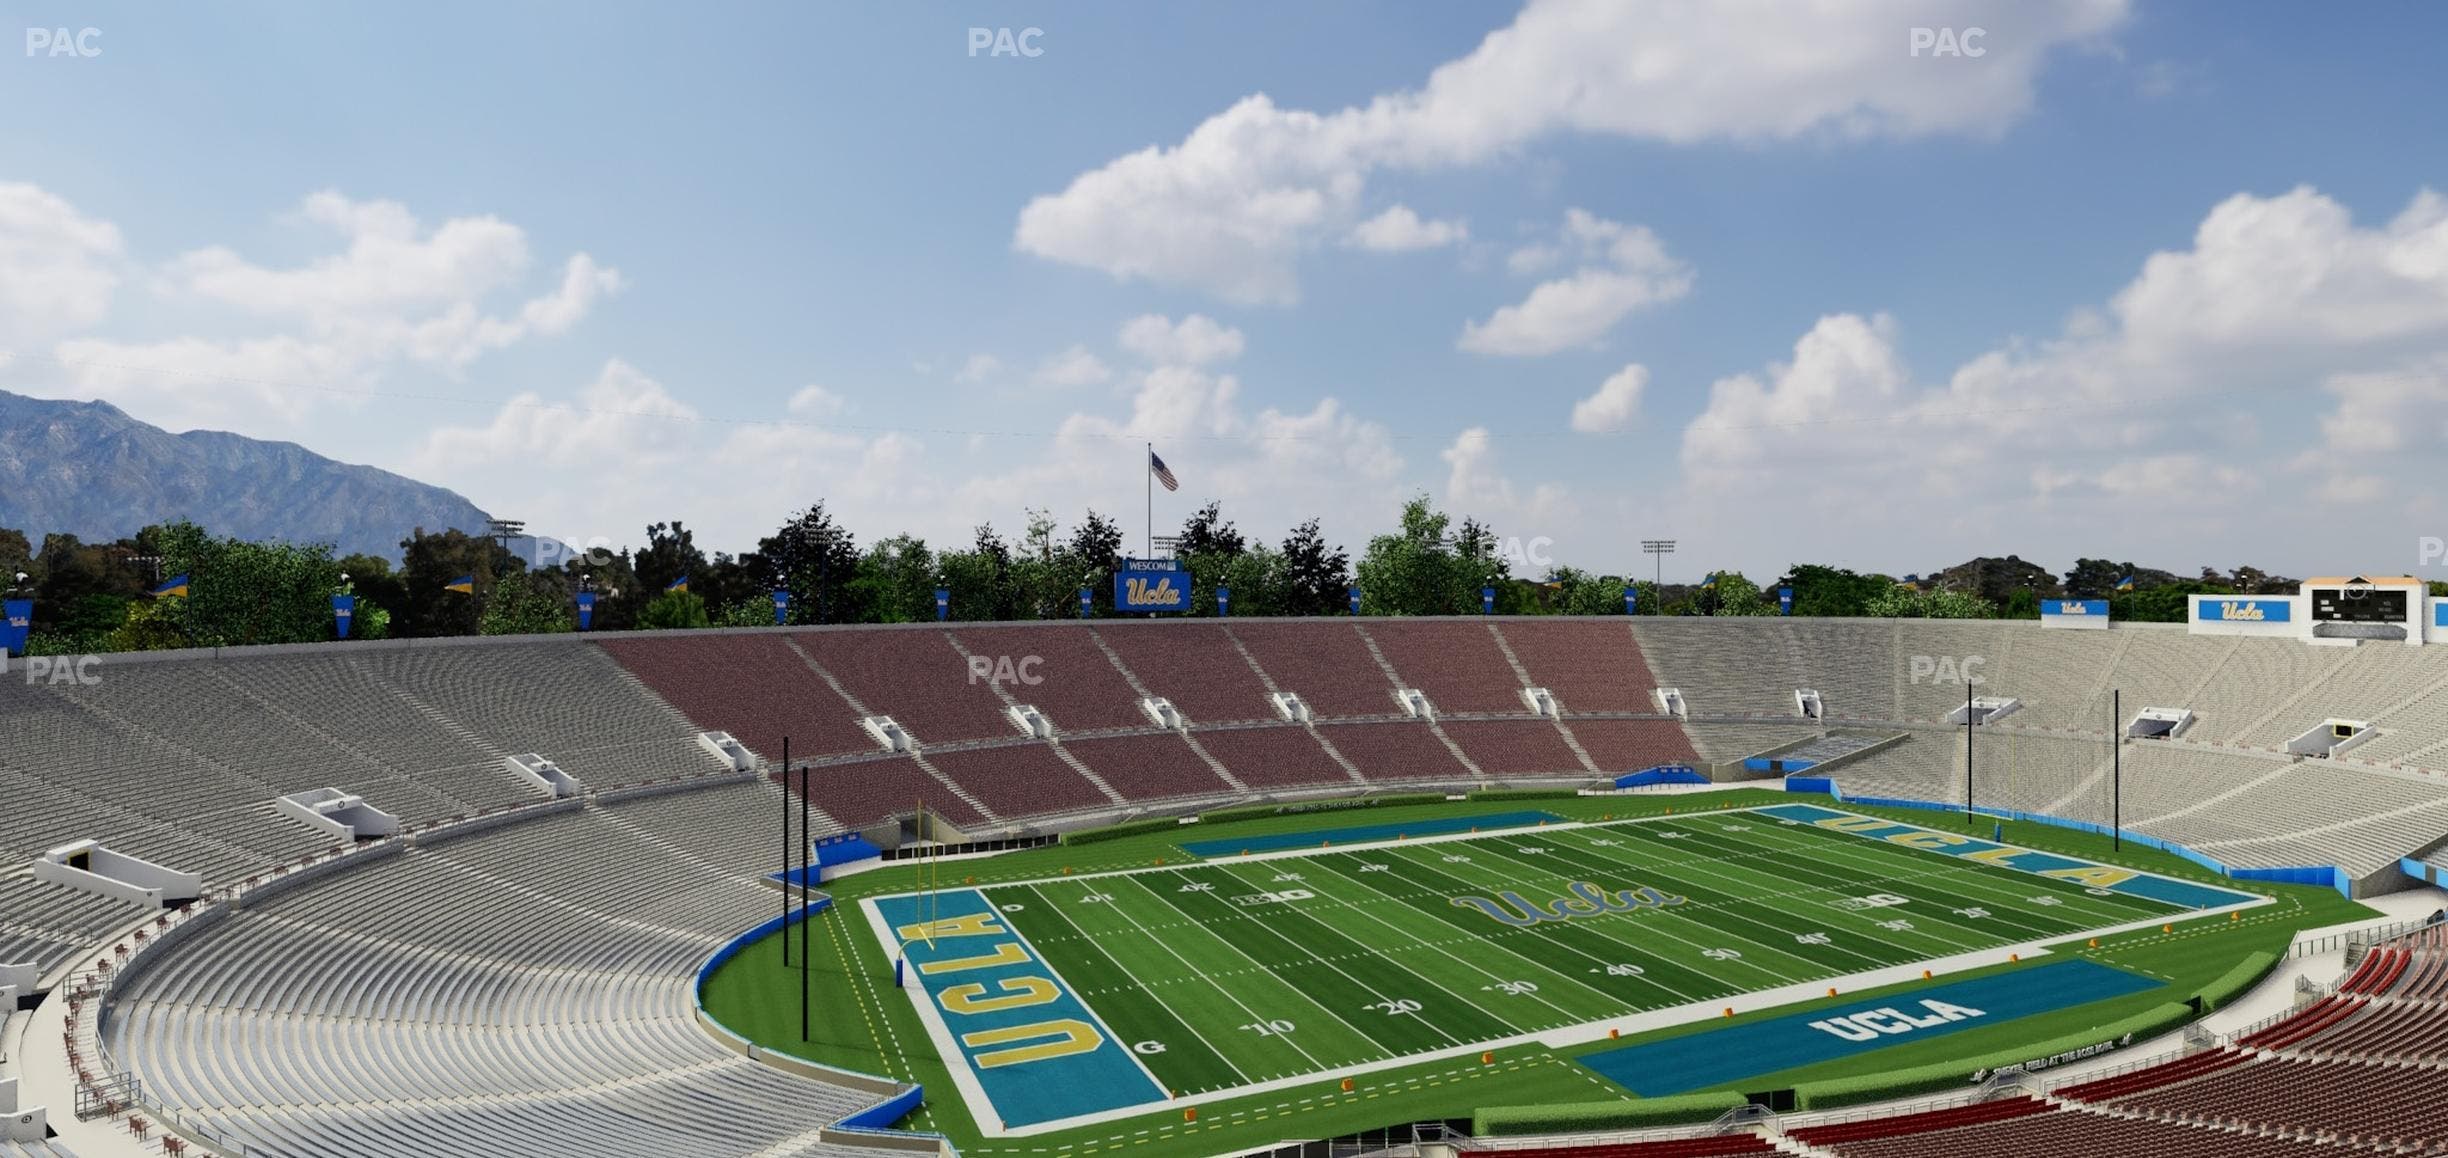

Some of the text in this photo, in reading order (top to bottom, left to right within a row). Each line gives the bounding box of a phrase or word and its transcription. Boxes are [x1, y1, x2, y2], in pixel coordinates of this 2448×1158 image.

[1129, 561, 1167, 570] WESCOM
[1126, 578, 1181, 604] Ucla
[1814, 816, 2140, 887] UCLA
[1450, 881, 1687, 926] Ucla
[1702, 948, 1741, 961] 50
[1606, 963, 1644, 976] 40
[897, 913, 1104, 1069] UCLA
[1495, 981, 1538, 995] 30
[1376, 999, 1423, 1015] 20
[1250, 1020, 1295, 1036] 10
[1807, 999, 1987, 1042] UCLA
[1134, 1040, 1167, 1055] G
[2049, 1054, 2060, 1066] AT
